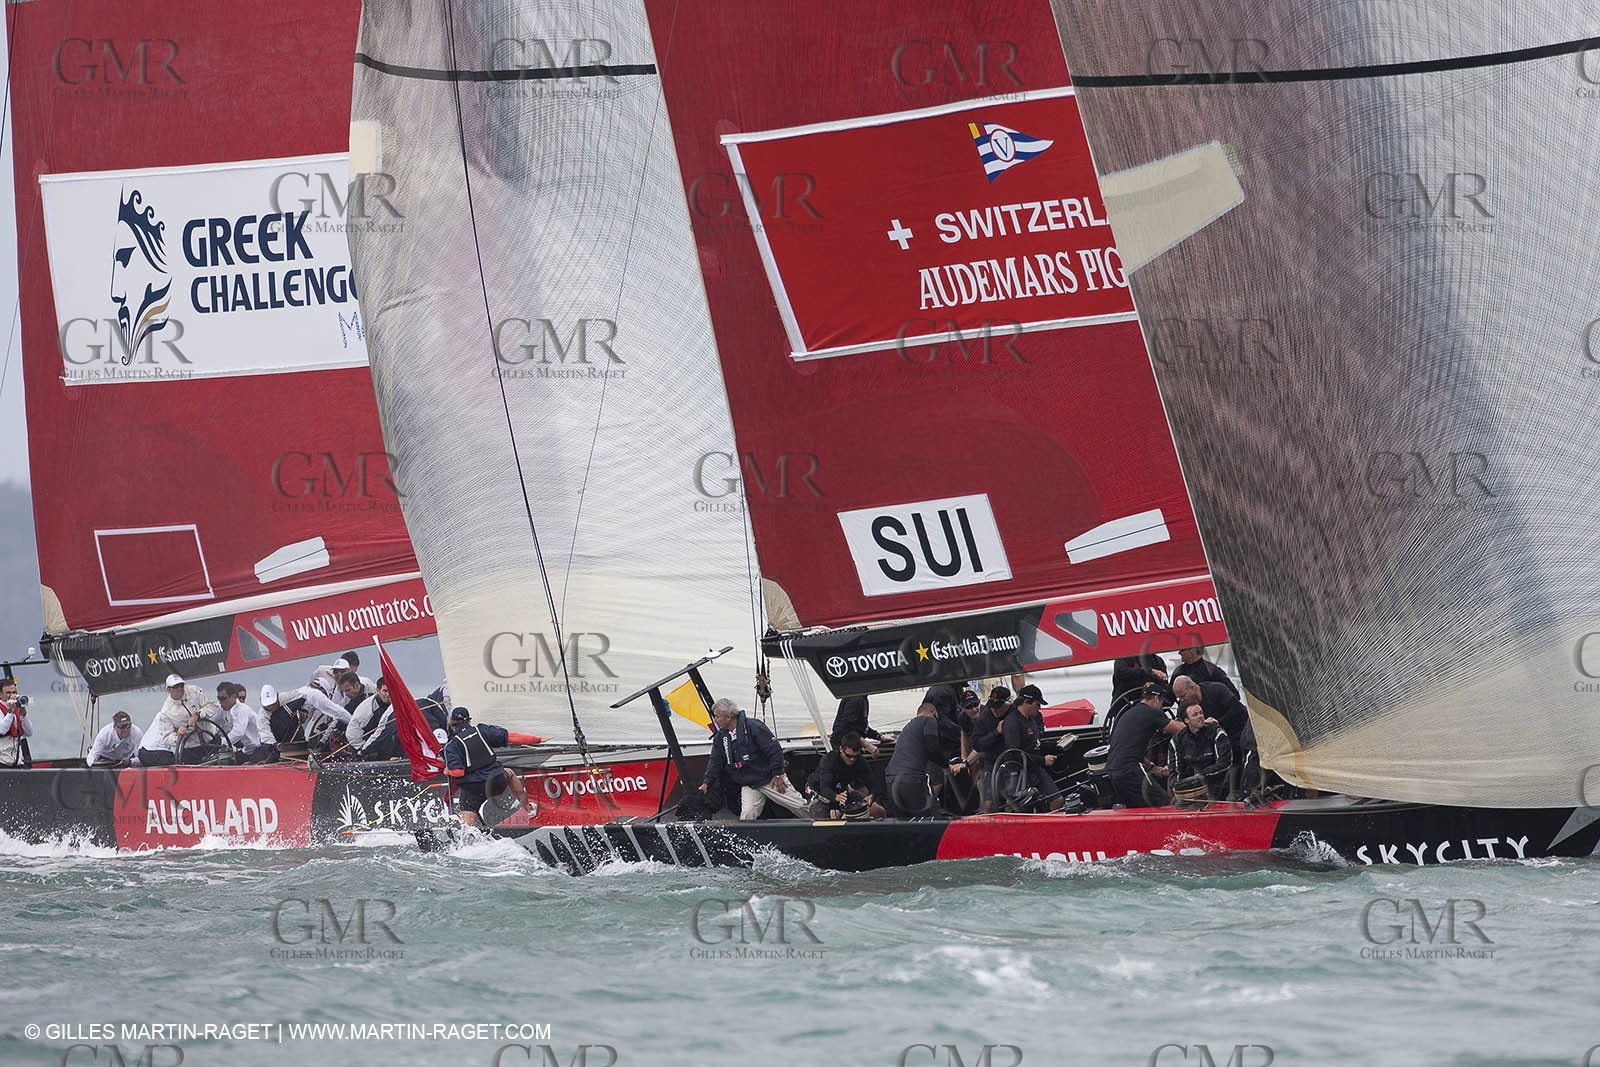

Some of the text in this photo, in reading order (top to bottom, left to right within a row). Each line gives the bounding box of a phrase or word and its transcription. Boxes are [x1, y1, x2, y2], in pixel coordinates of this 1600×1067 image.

[182, 210, 314, 268] GREEK
[934, 197, 1111, 244] SWITZERL
[919, 246, 1129, 310] AUDEMARS PIG
[871, 507, 984, 583] SUI
[100, 653, 143, 674] TOYOTA
[848, 650, 909, 673] TOYOTA
[562, 773, 648, 796] vodafone
[145, 798, 279, 835] AUCKLAND
[1356, 835, 1530, 866] SKYCITY
